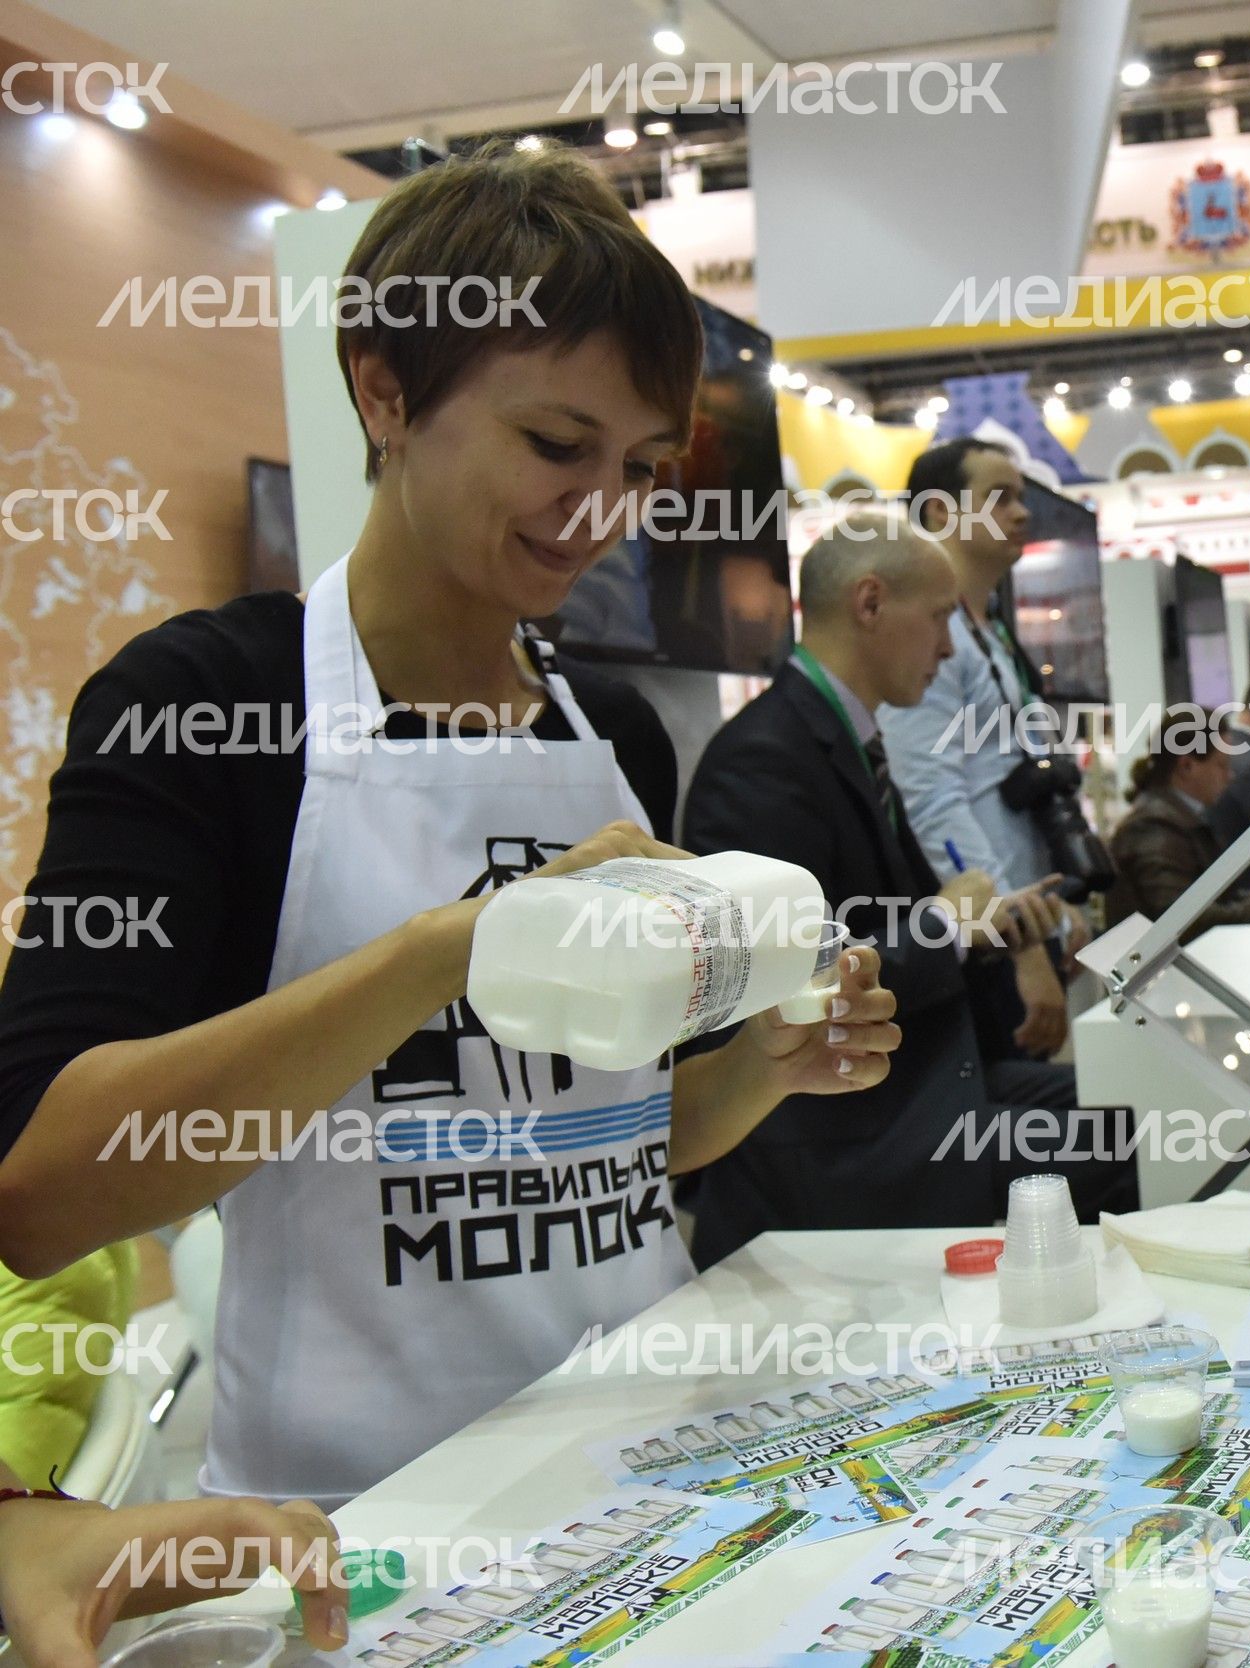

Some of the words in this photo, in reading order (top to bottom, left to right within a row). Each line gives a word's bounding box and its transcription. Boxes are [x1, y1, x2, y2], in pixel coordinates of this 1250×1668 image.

[1087, 217, 1159, 252] СТЬ
[383, 1184, 674, 1286] МОЛОК
[990, 1362, 1102, 1380] ПРАВИЛЬН
[990, 1366, 1109, 1388] МОЛОК
[1011, 1398, 1065, 1435] ОЛОК
[738, 1420, 884, 1468] МОЛОКО
[528, 1554, 668, 1634] ПРАВИЛЬНОЕ
[543, 1556, 690, 1639] МОЛОКО
[975, 1539, 1077, 1625] ПРАВИЛЬНО
